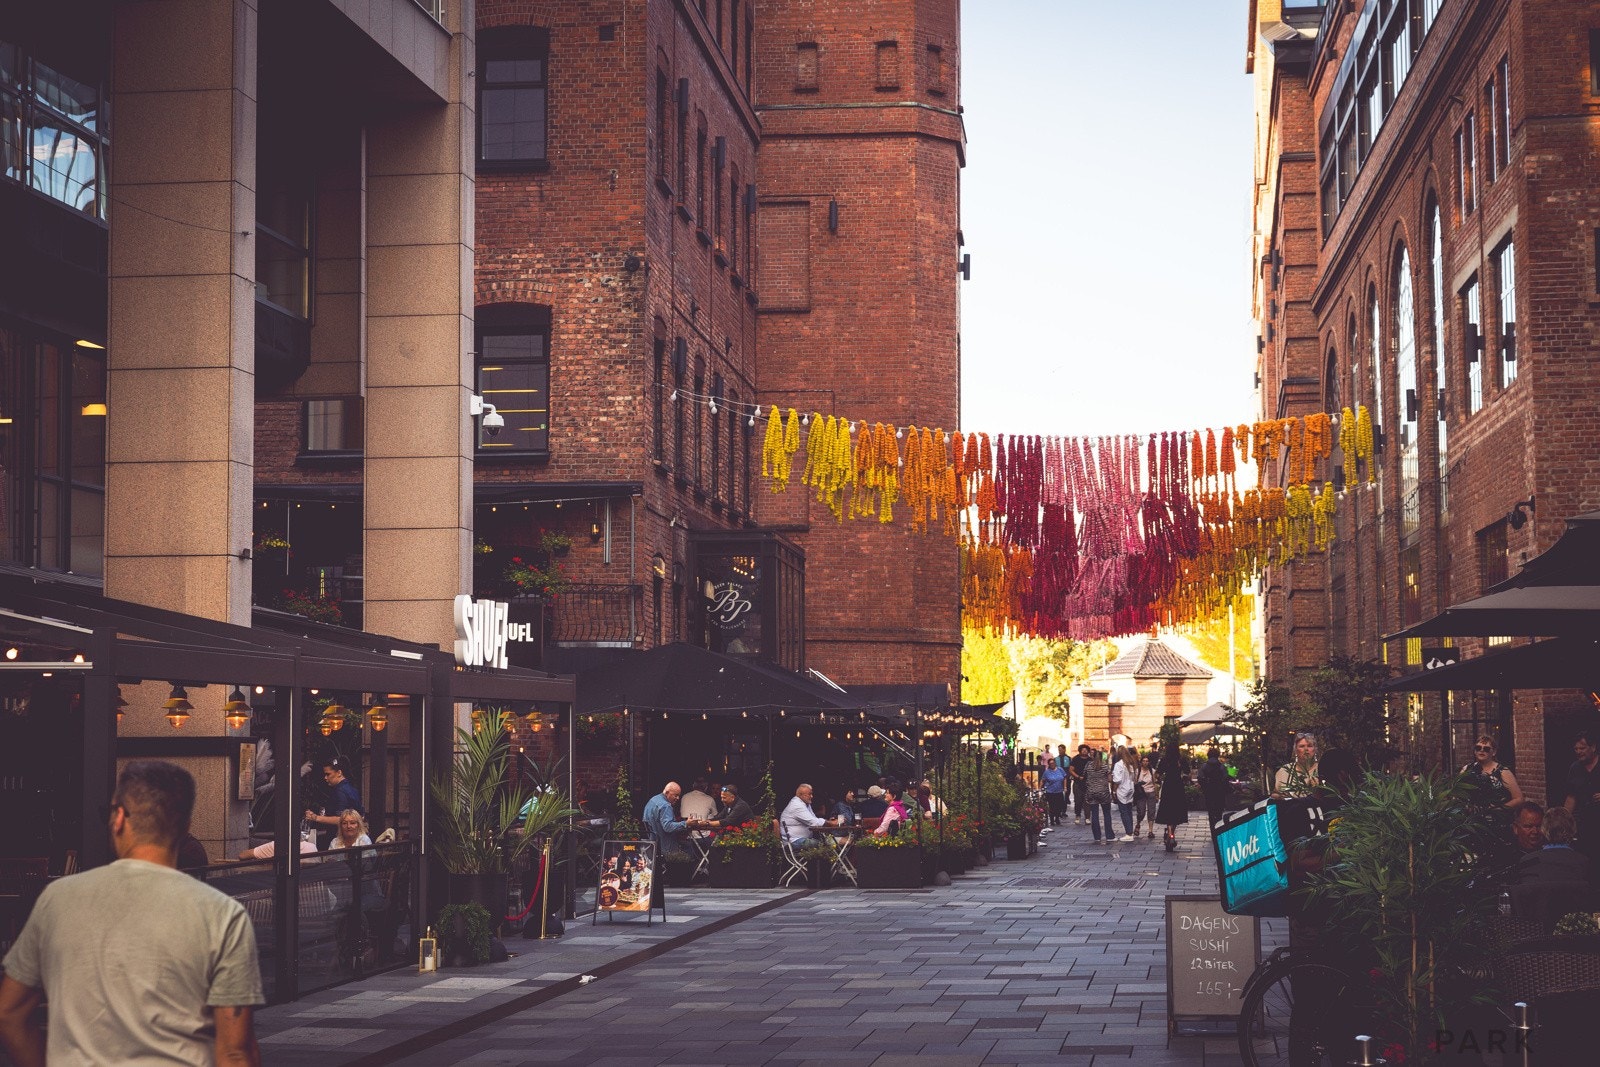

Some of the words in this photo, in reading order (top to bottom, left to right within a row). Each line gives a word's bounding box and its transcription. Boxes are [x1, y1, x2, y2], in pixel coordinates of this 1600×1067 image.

[454, 594, 509, 670] SHUFL
[1226, 834, 1260, 866] Wolt
[1180, 915, 1240, 935] DAGENS
[1190, 957, 1204, 970] 12
